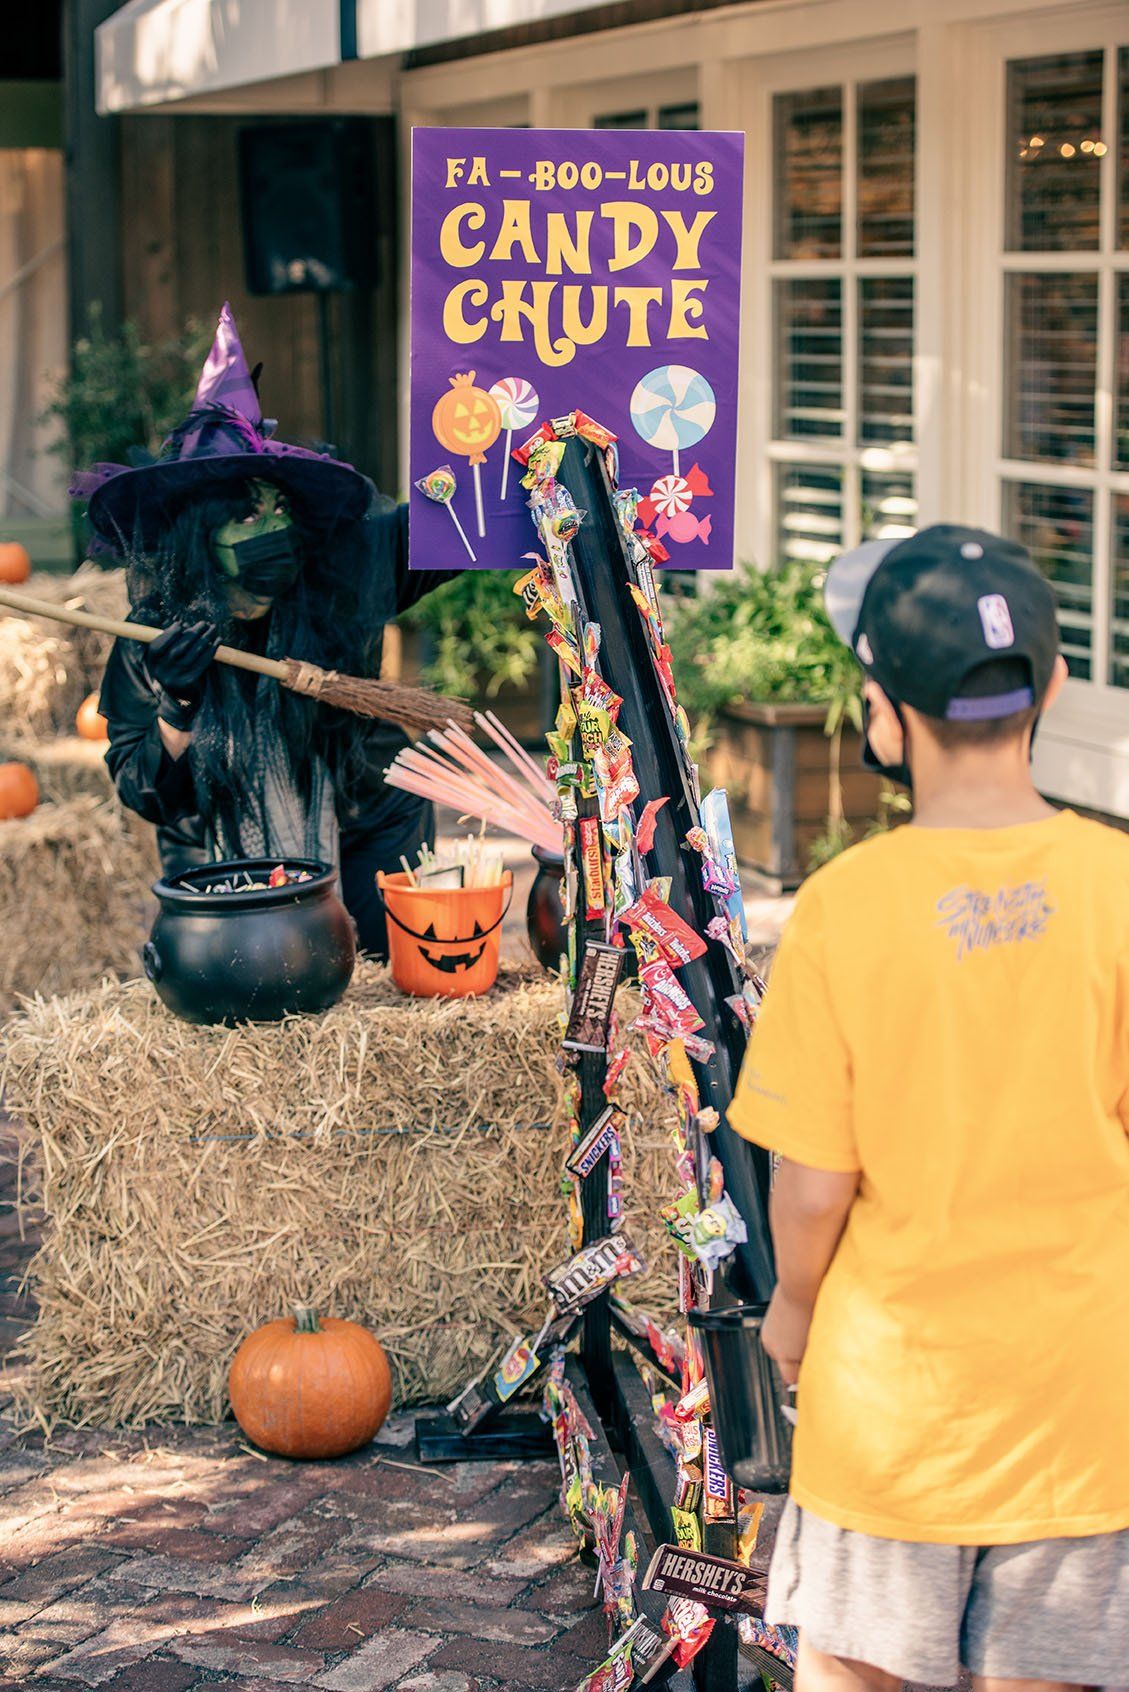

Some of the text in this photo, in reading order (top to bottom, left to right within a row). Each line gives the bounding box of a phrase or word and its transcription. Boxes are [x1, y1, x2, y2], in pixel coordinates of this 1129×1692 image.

[440, 200, 718, 275] CANDY
[443, 279, 709, 367] CHUTE
[586, 952, 620, 1021] HERSHEY'S
[580, 1125, 616, 1173] SNICKERS
[661, 1553, 747, 1596] HERSHEY'S
[692, 1586, 706, 1595] milk
[707, 1589, 738, 1603] chocolate
